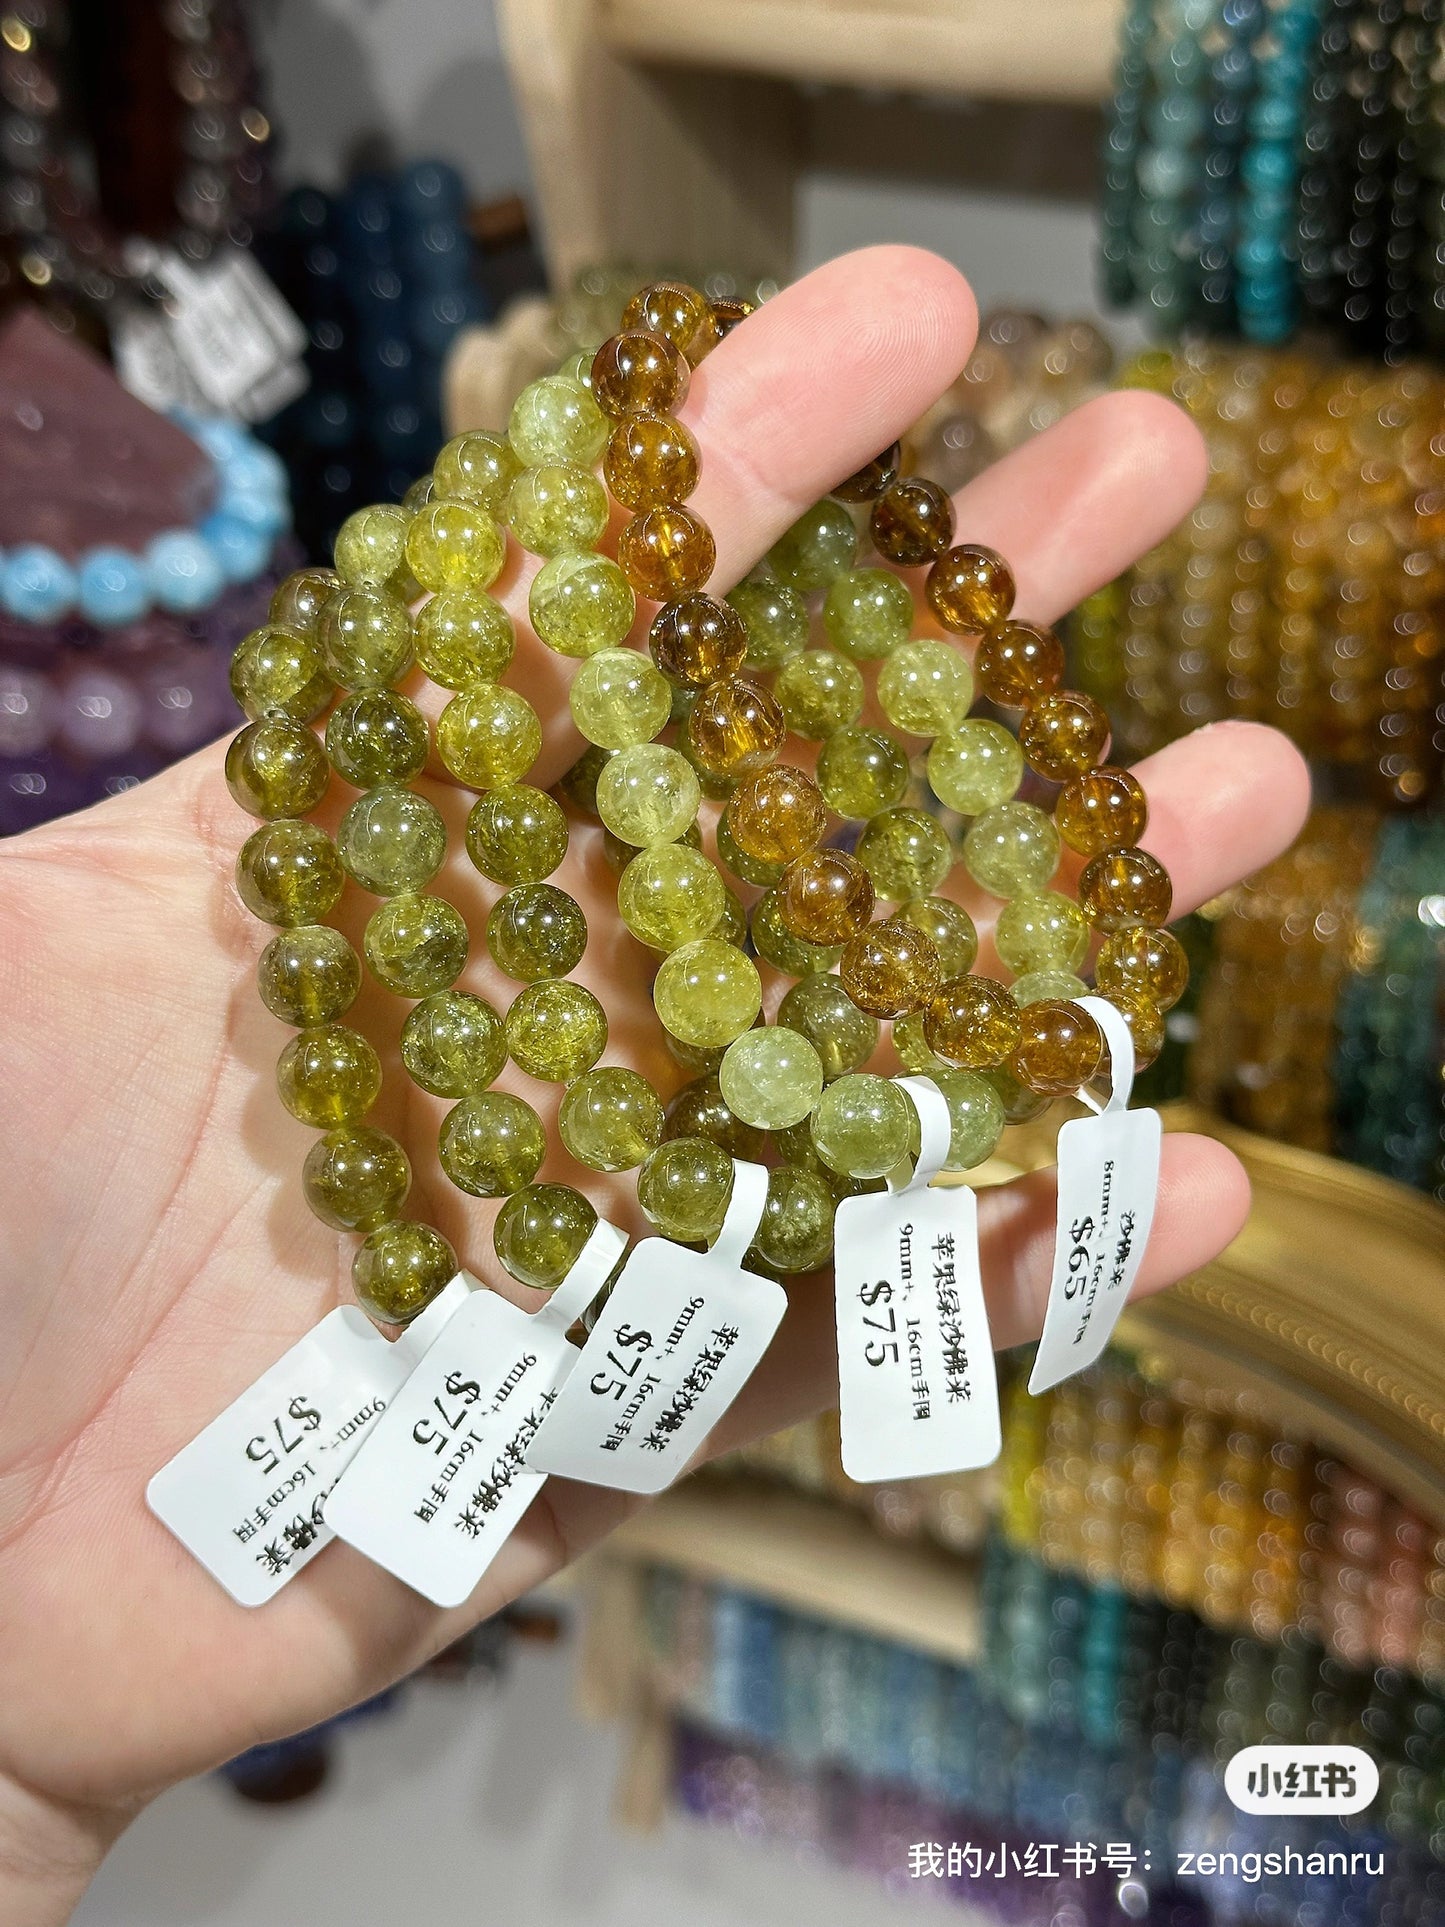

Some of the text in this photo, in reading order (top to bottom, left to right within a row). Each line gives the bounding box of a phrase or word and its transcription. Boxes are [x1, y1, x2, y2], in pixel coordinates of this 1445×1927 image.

[1064, 1215, 1096, 1301] $65
[855, 1279, 900, 1367] $75
[930, 1232, 972, 1404] 苹果绿沙佛莱
[589, 1323, 654, 1401] $75
[244, 1395, 324, 1475] $75
[411, 1370, 484, 1456] $75
